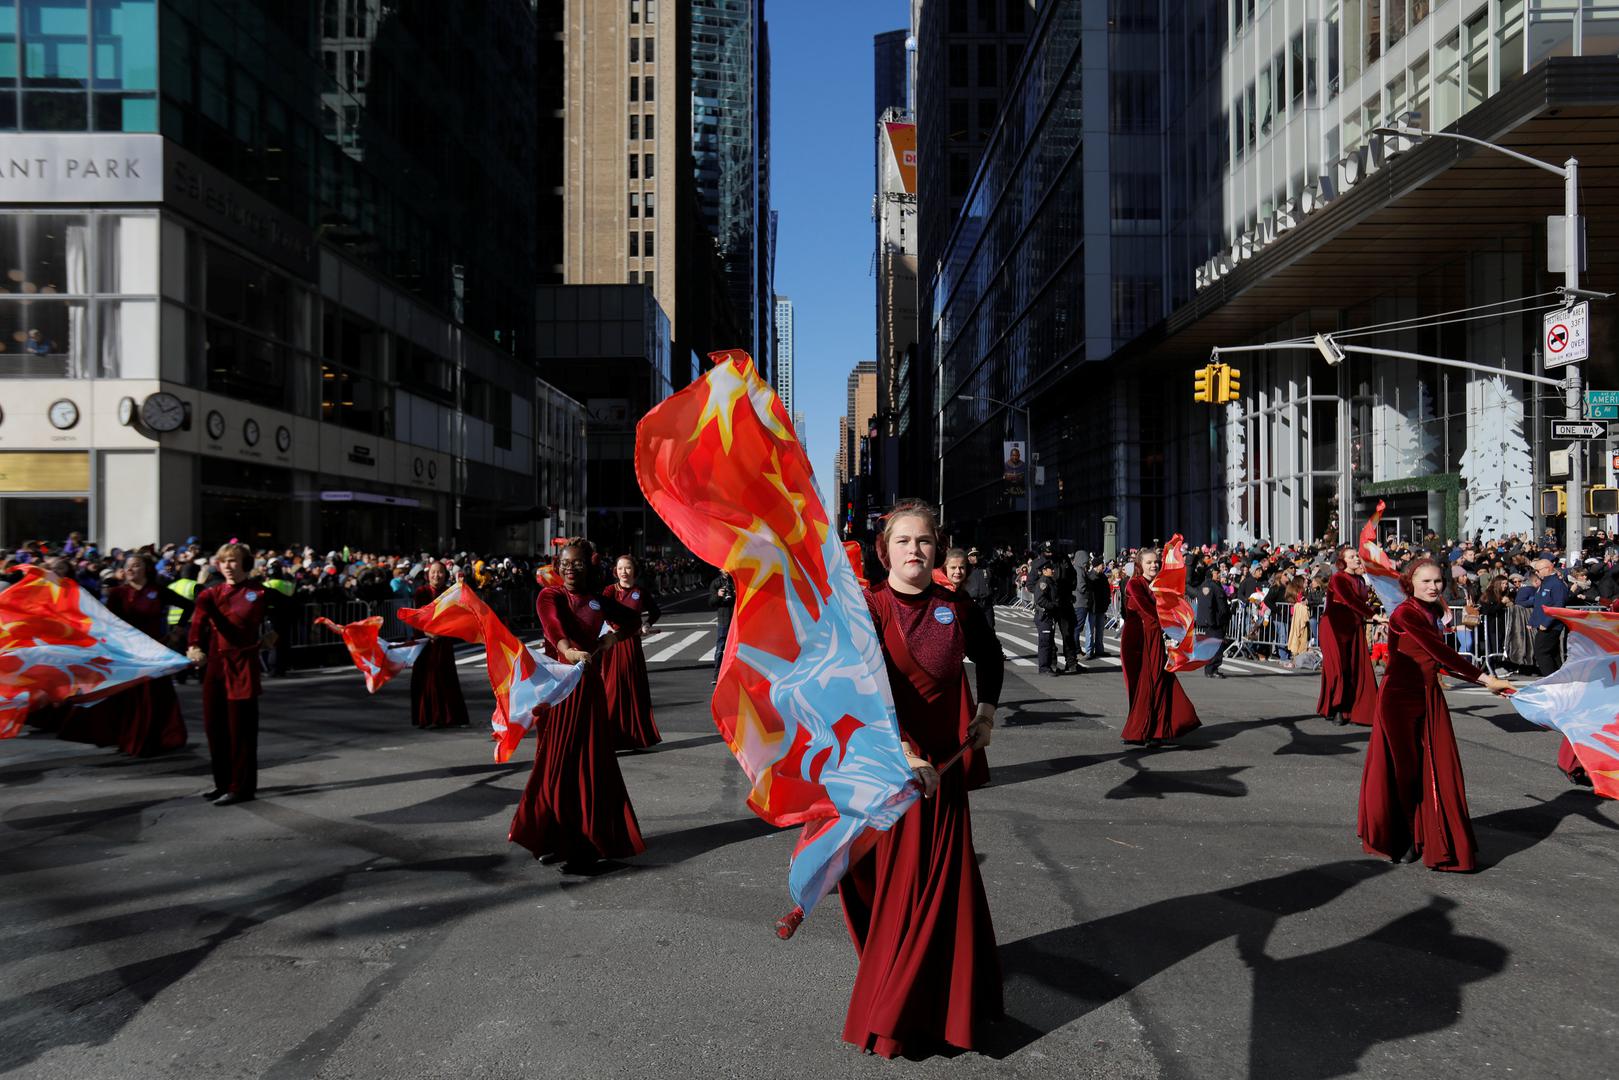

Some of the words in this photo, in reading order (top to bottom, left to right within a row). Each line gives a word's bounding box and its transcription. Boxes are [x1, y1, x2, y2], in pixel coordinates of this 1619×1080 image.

[66, 159, 141, 178] PARK
[1572, 307, 1585, 316] AREA
[1571, 339, 1585, 349] OVER
[1594, 407, 1602, 416] 6
[1560, 426, 1576, 434] ONE
[1583, 426, 1600, 434] WAY
